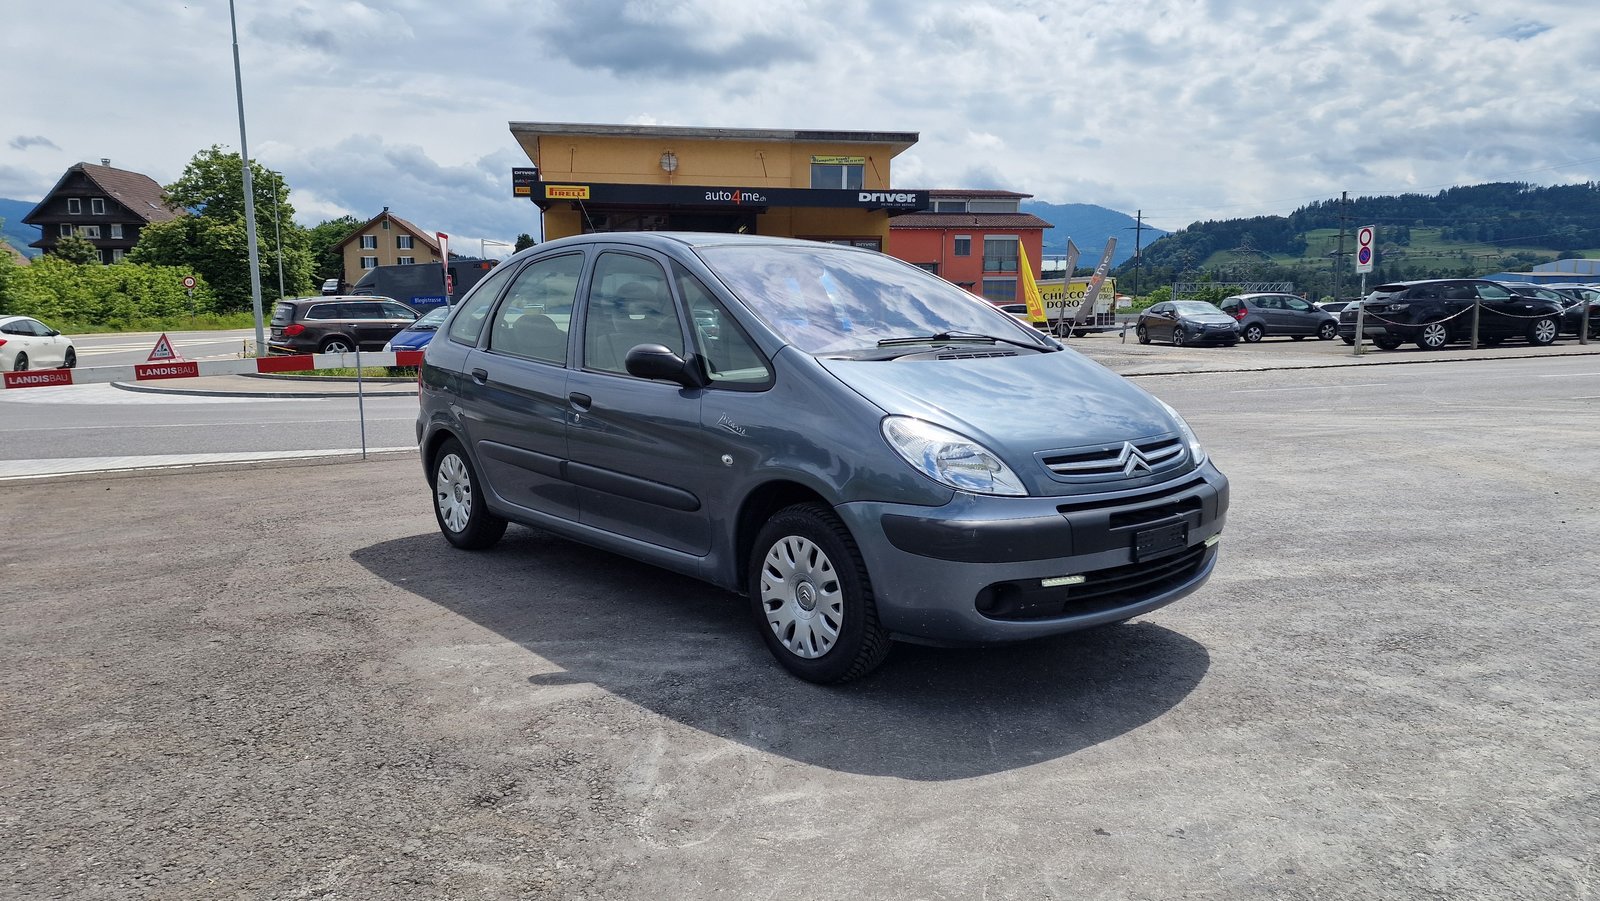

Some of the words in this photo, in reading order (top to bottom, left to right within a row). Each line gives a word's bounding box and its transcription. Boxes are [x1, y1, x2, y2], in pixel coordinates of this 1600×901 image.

[549, 187, 586, 197] PIRELLI
[139, 366, 195, 377] LANDISBAU
[8, 374, 69, 386] LANDISBAU
